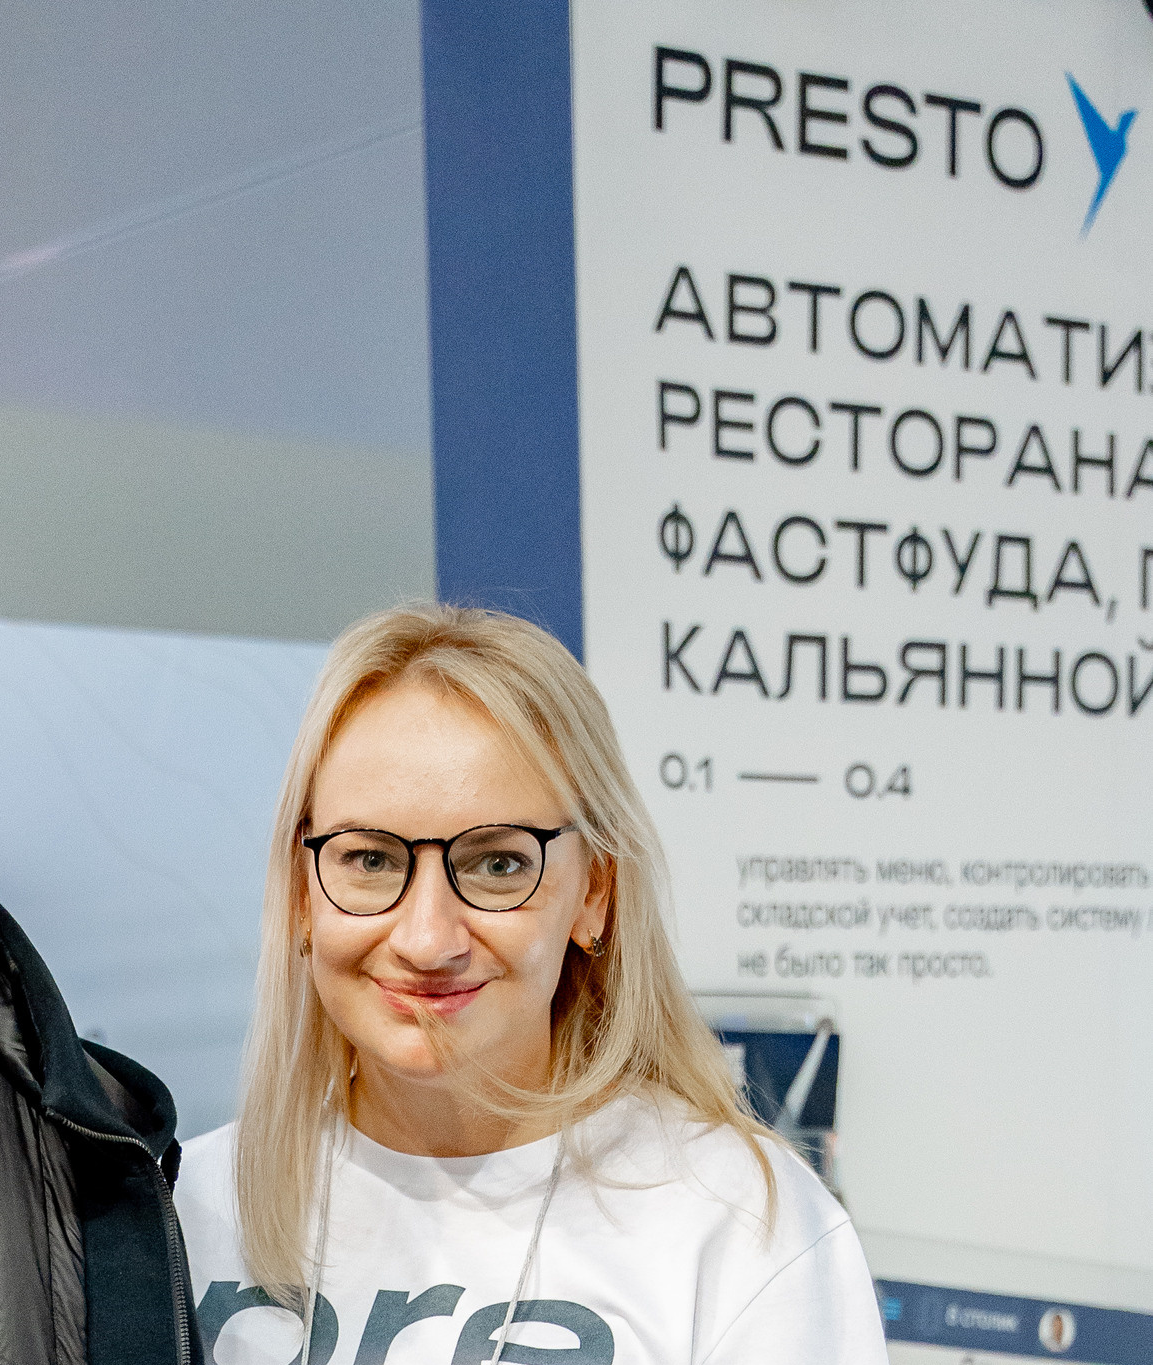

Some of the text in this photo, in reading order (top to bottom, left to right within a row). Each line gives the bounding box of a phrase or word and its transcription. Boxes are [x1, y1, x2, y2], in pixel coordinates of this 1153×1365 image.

[651, 43, 1047, 193] PRESTO
[653, 263, 1153, 395] АВТОМАТИ
[657, 501, 1118, 621] ФАСТФУДА,
[737, 856, 868, 889] управлять
